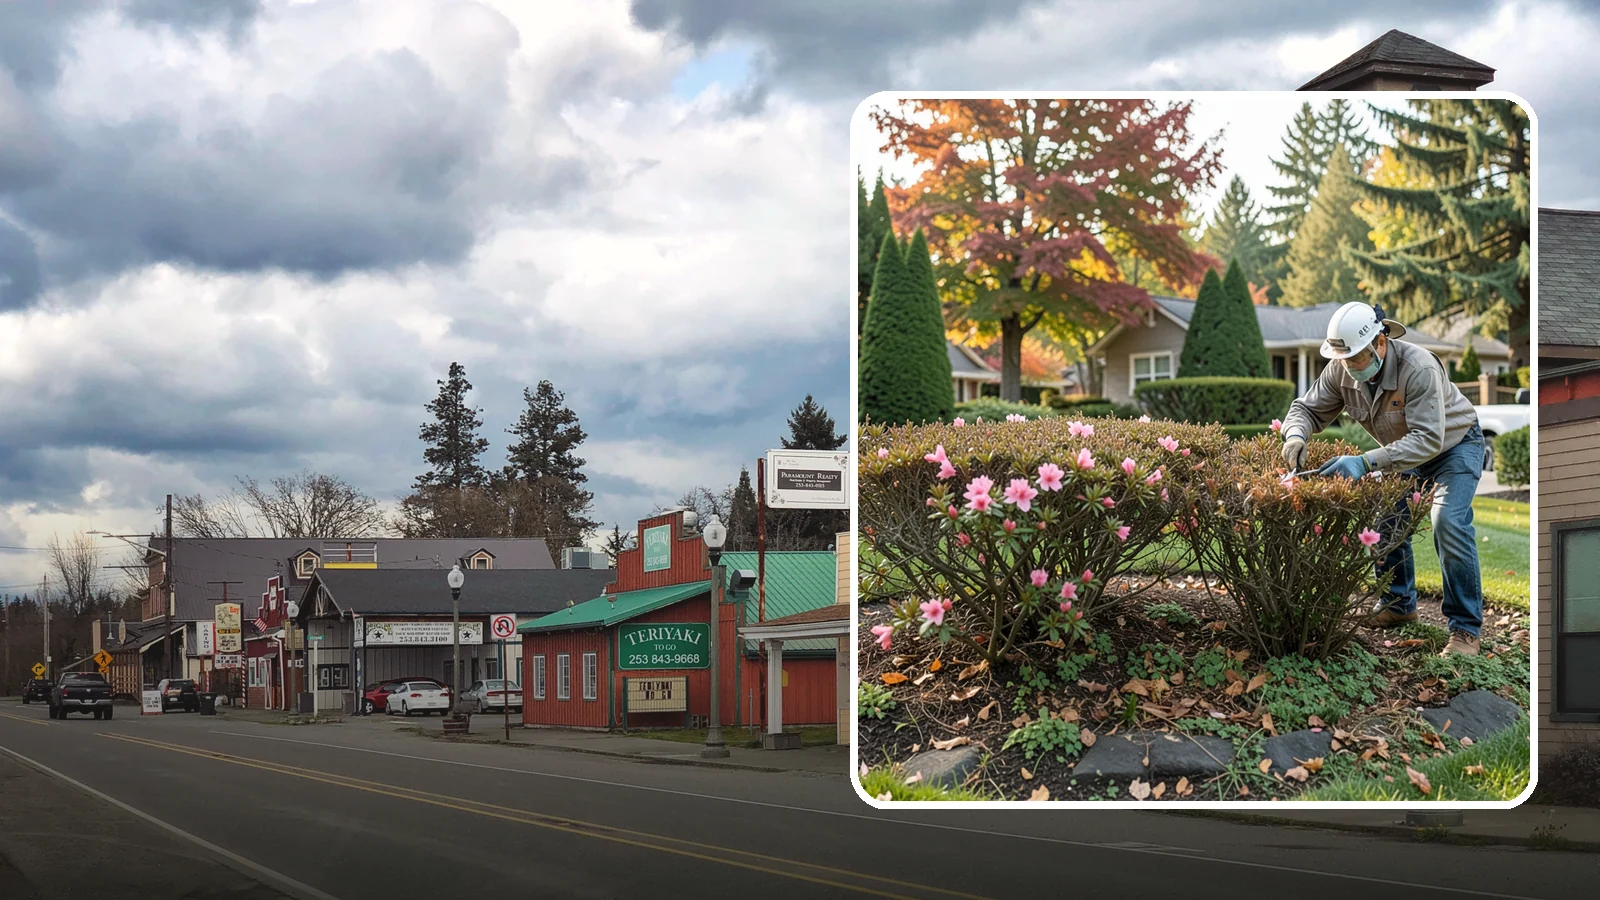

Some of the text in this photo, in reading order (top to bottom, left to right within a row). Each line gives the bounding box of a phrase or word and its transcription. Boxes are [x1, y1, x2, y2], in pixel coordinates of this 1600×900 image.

[625, 627, 702, 646] TERIYAKI
[629, 654, 700, 665] 253 843-9668
